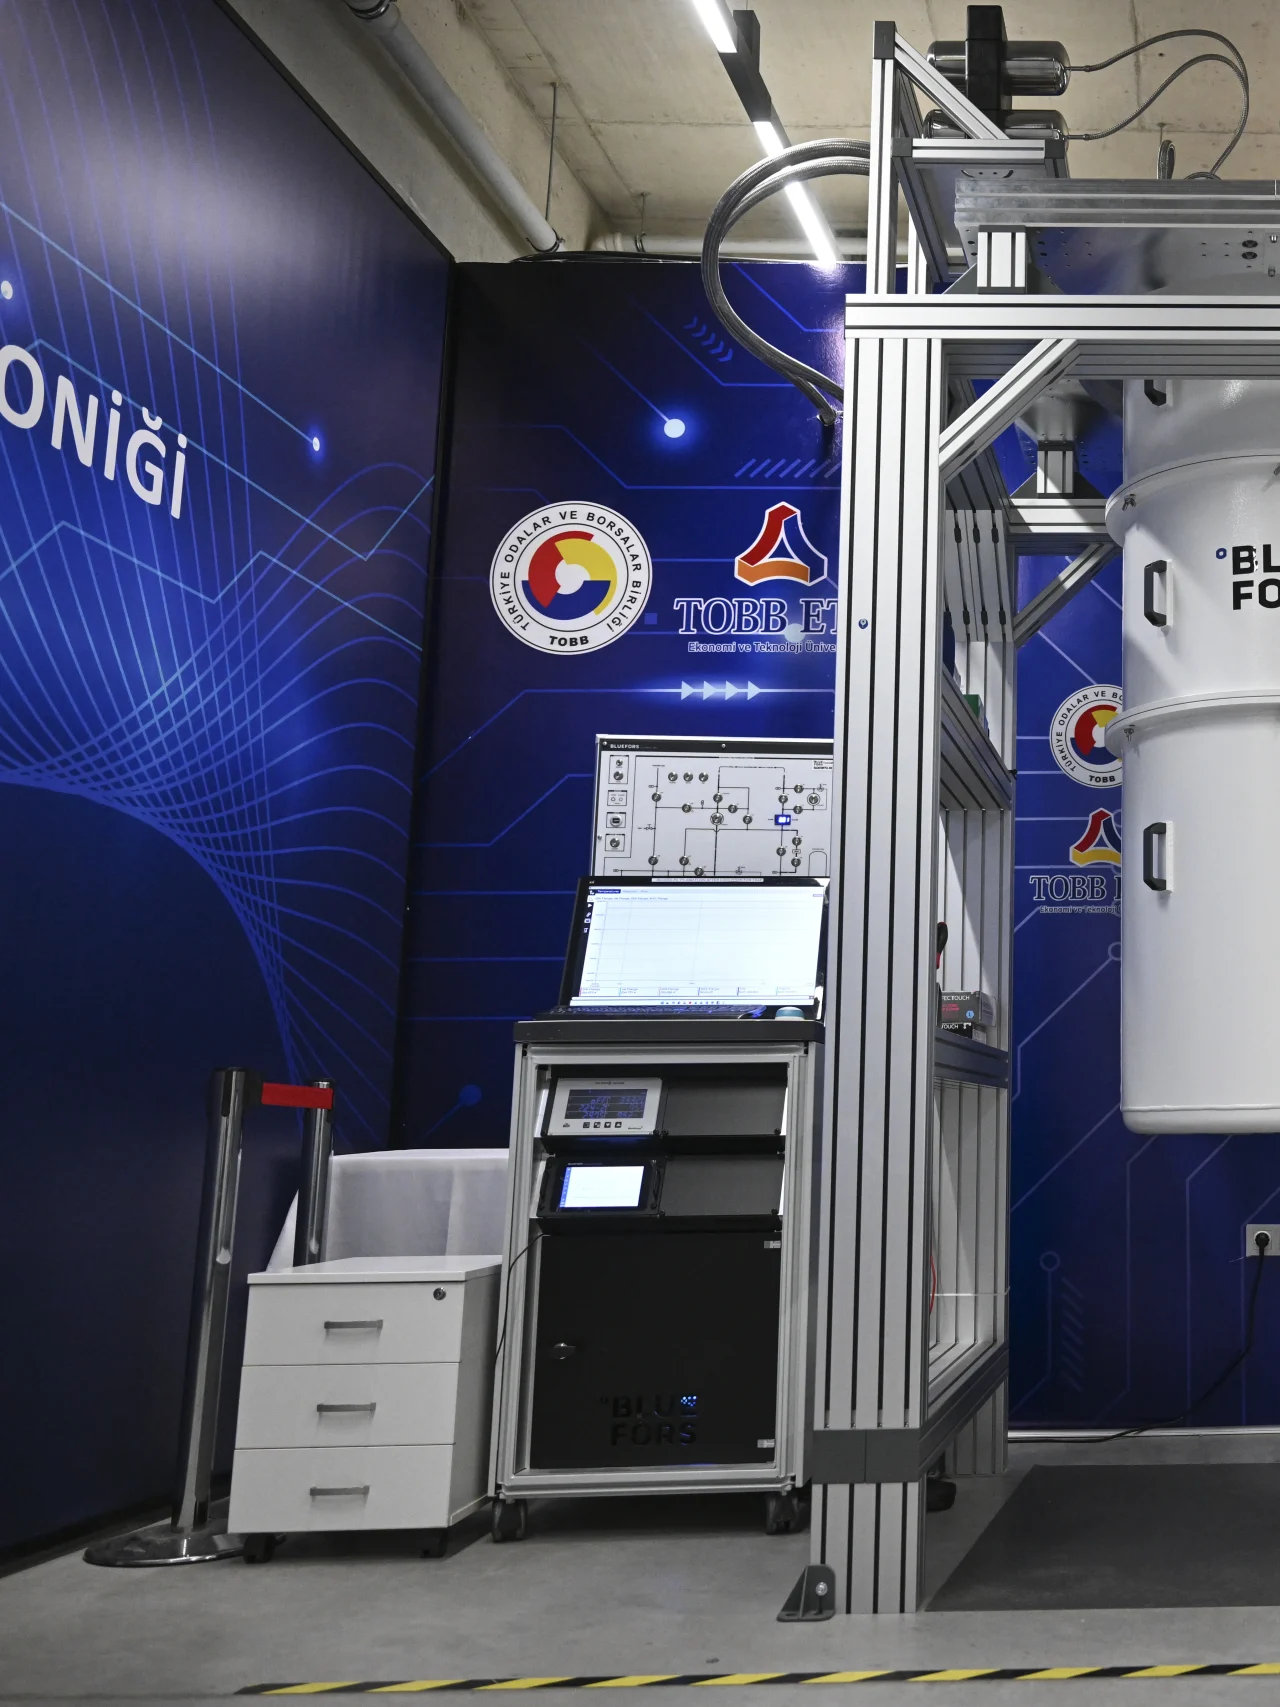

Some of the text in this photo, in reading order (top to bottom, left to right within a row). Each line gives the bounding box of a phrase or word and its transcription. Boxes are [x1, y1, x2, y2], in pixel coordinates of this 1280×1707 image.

[0, 345, 187, 519] ONİĞİ
[499, 510, 642, 632] TÜRKİYE ODALAR VE BORSALAR BİRLİĞİ
[673, 597, 788, 635] TOBB
[549, 635, 589, 646] TOBB
[688, 641, 736, 653] Ekonomi
[738, 643, 751, 653] ve
[753, 641, 803, 654] Teknoloji
[1058, 694, 1089, 726] ODALAR
[1089, 775, 1116, 783] TOBB
[1029, 875, 1107, 901] TOBB
